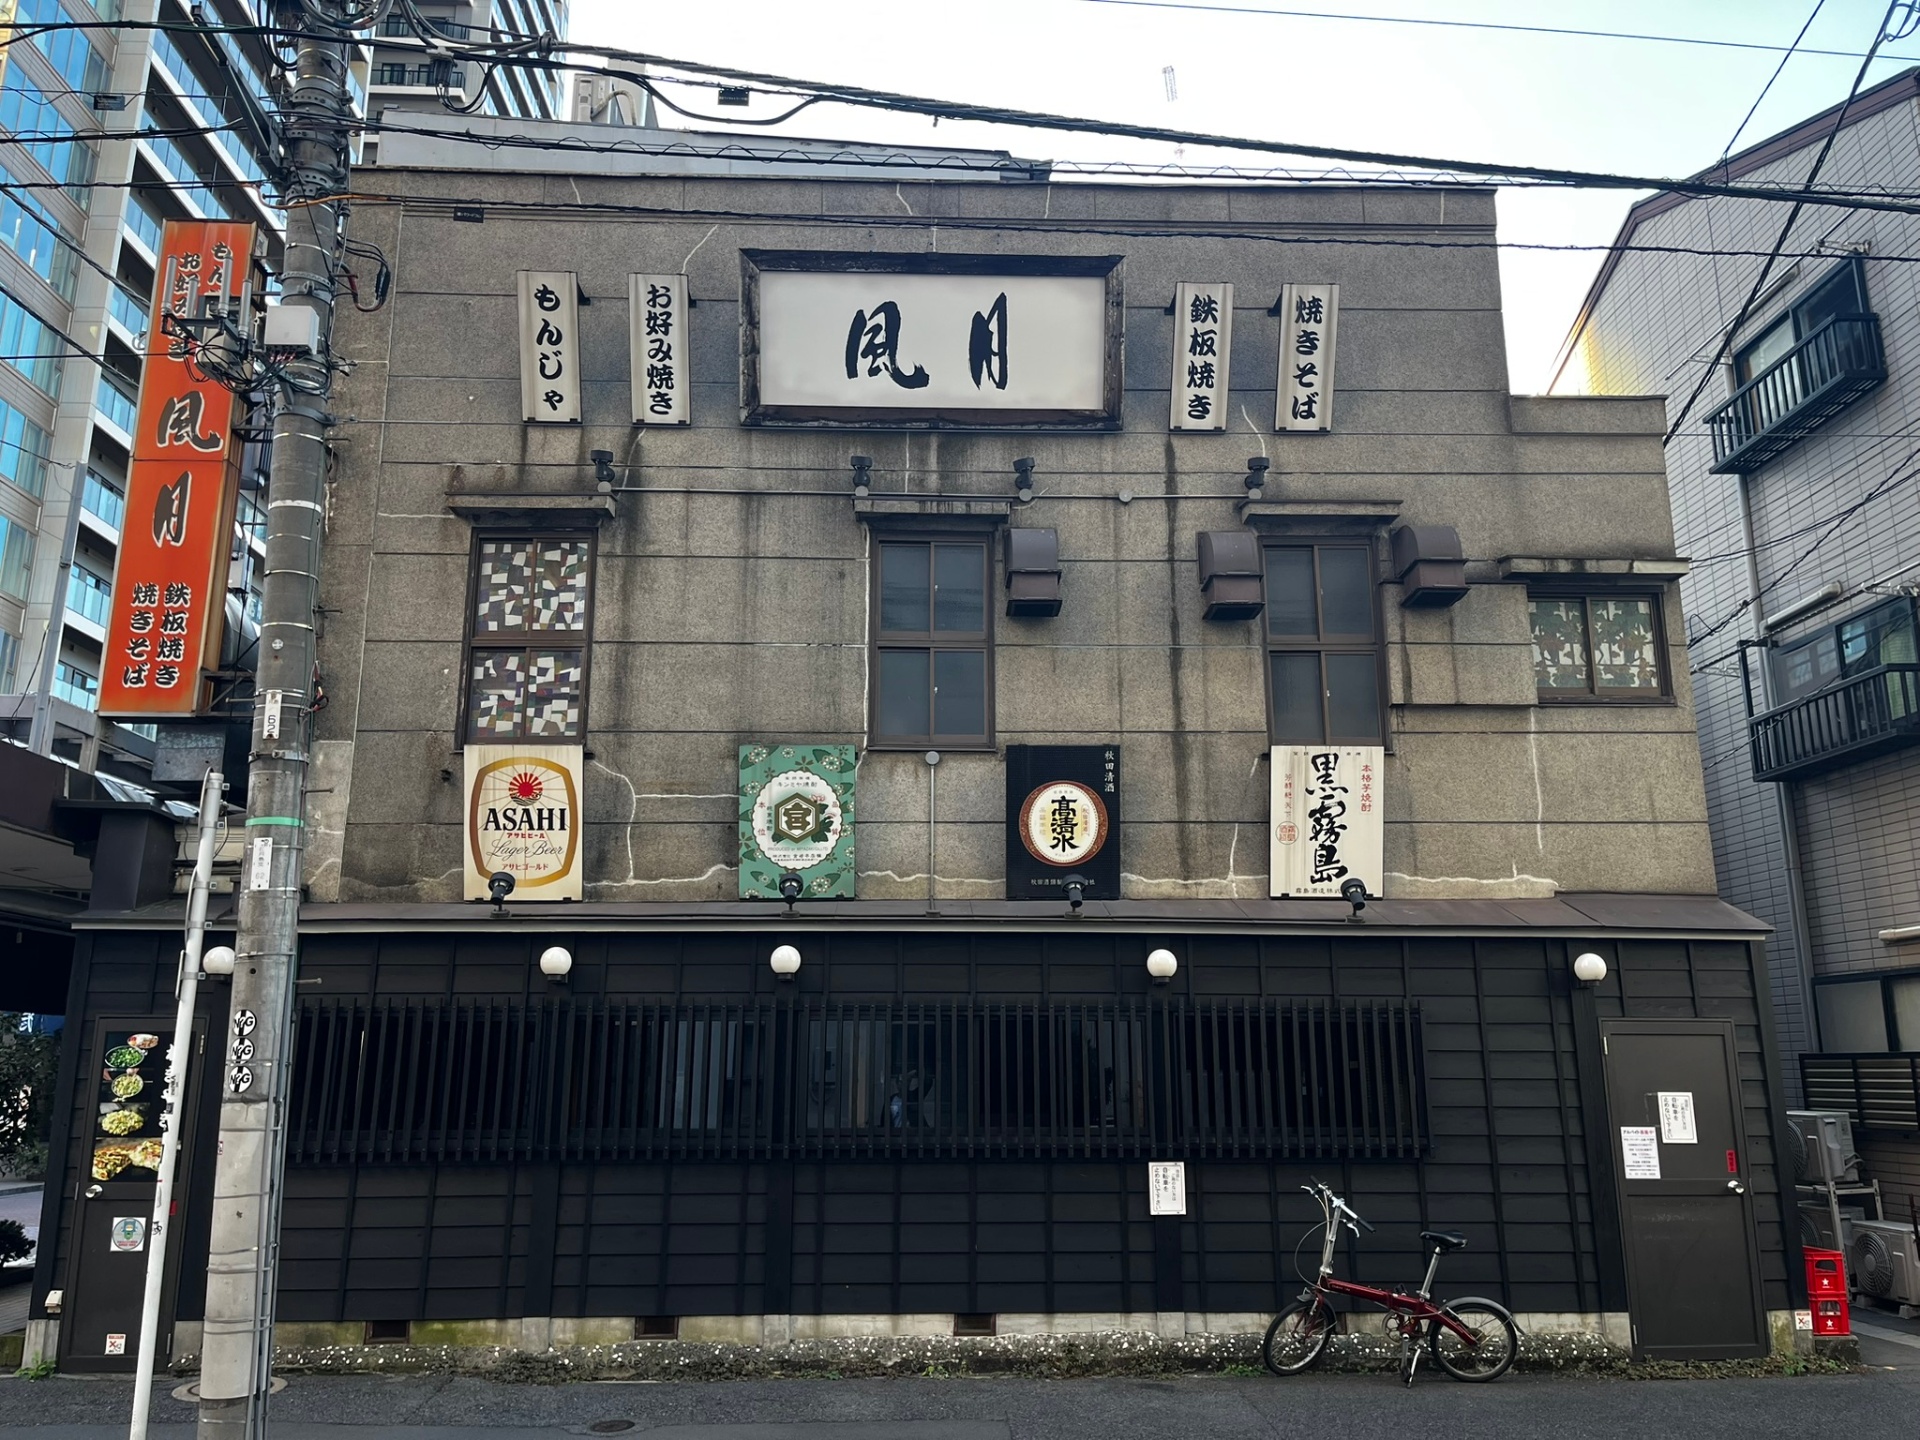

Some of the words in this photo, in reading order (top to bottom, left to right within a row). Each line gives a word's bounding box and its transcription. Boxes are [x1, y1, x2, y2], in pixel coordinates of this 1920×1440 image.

[534, 284, 564, 411] もんじゃ
[646, 284, 675, 415] お好み焼き
[845, 292, 1008, 391] 風月
[1187, 293, 1218, 419] 鉄板焼き
[1292, 295, 1324, 420] 焼きそば
[152, 390, 224, 548] 風月
[122, 582, 159, 688] 焼きそば
[155, 582, 191, 688] 鉄板焼き
[267, 714, 276, 733] 62
[1104, 750, 1115, 793] 秋田清酒
[483, 807, 568, 831] ASAHI
[1305, 752, 1349, 885] 黒霧島
[1360, 764, 1373, 813] 本格芋焼酎
[486, 838, 531, 861] Lager
[525, 840, 564, 858] Beer
[501, 863, 549, 871] アサヒゴールド
